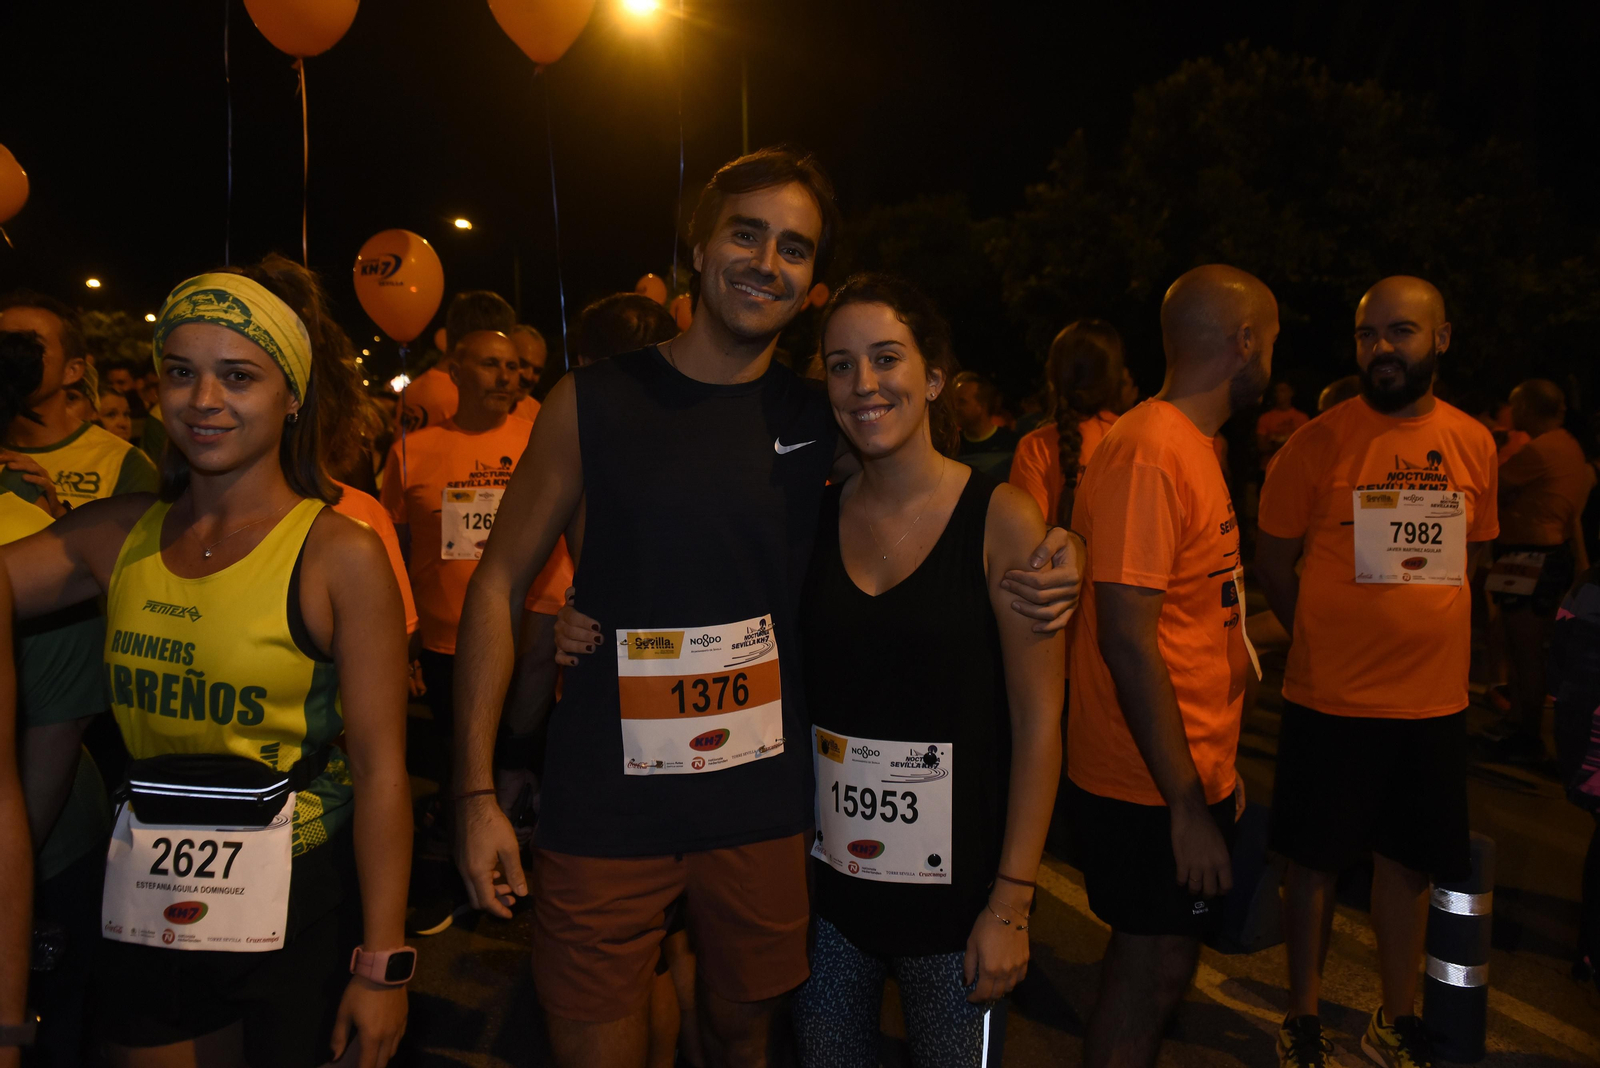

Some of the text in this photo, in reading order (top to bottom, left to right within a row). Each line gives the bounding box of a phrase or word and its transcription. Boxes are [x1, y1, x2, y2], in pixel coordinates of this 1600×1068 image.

[447, 480, 491, 488] SEVILLA
[469, 471, 511, 479] NOCTURN
[1386, 471, 1448, 482] NOCTURNA
[462, 512, 496, 529] 126
[1390, 521, 1443, 545] 7982
[142, 600, 190, 618] PENTEX
[111, 629, 196, 666] RUNNERS
[731, 641, 757, 650] SEVILLA
[105, 664, 268, 727] RREÑOS
[671, 672, 749, 714] 1376
[831, 781, 919, 824] 15953
[149, 837, 243, 879] 2627
[136, 881, 245, 895] ESTEFANIA AGUILA DOMINGUEZ
